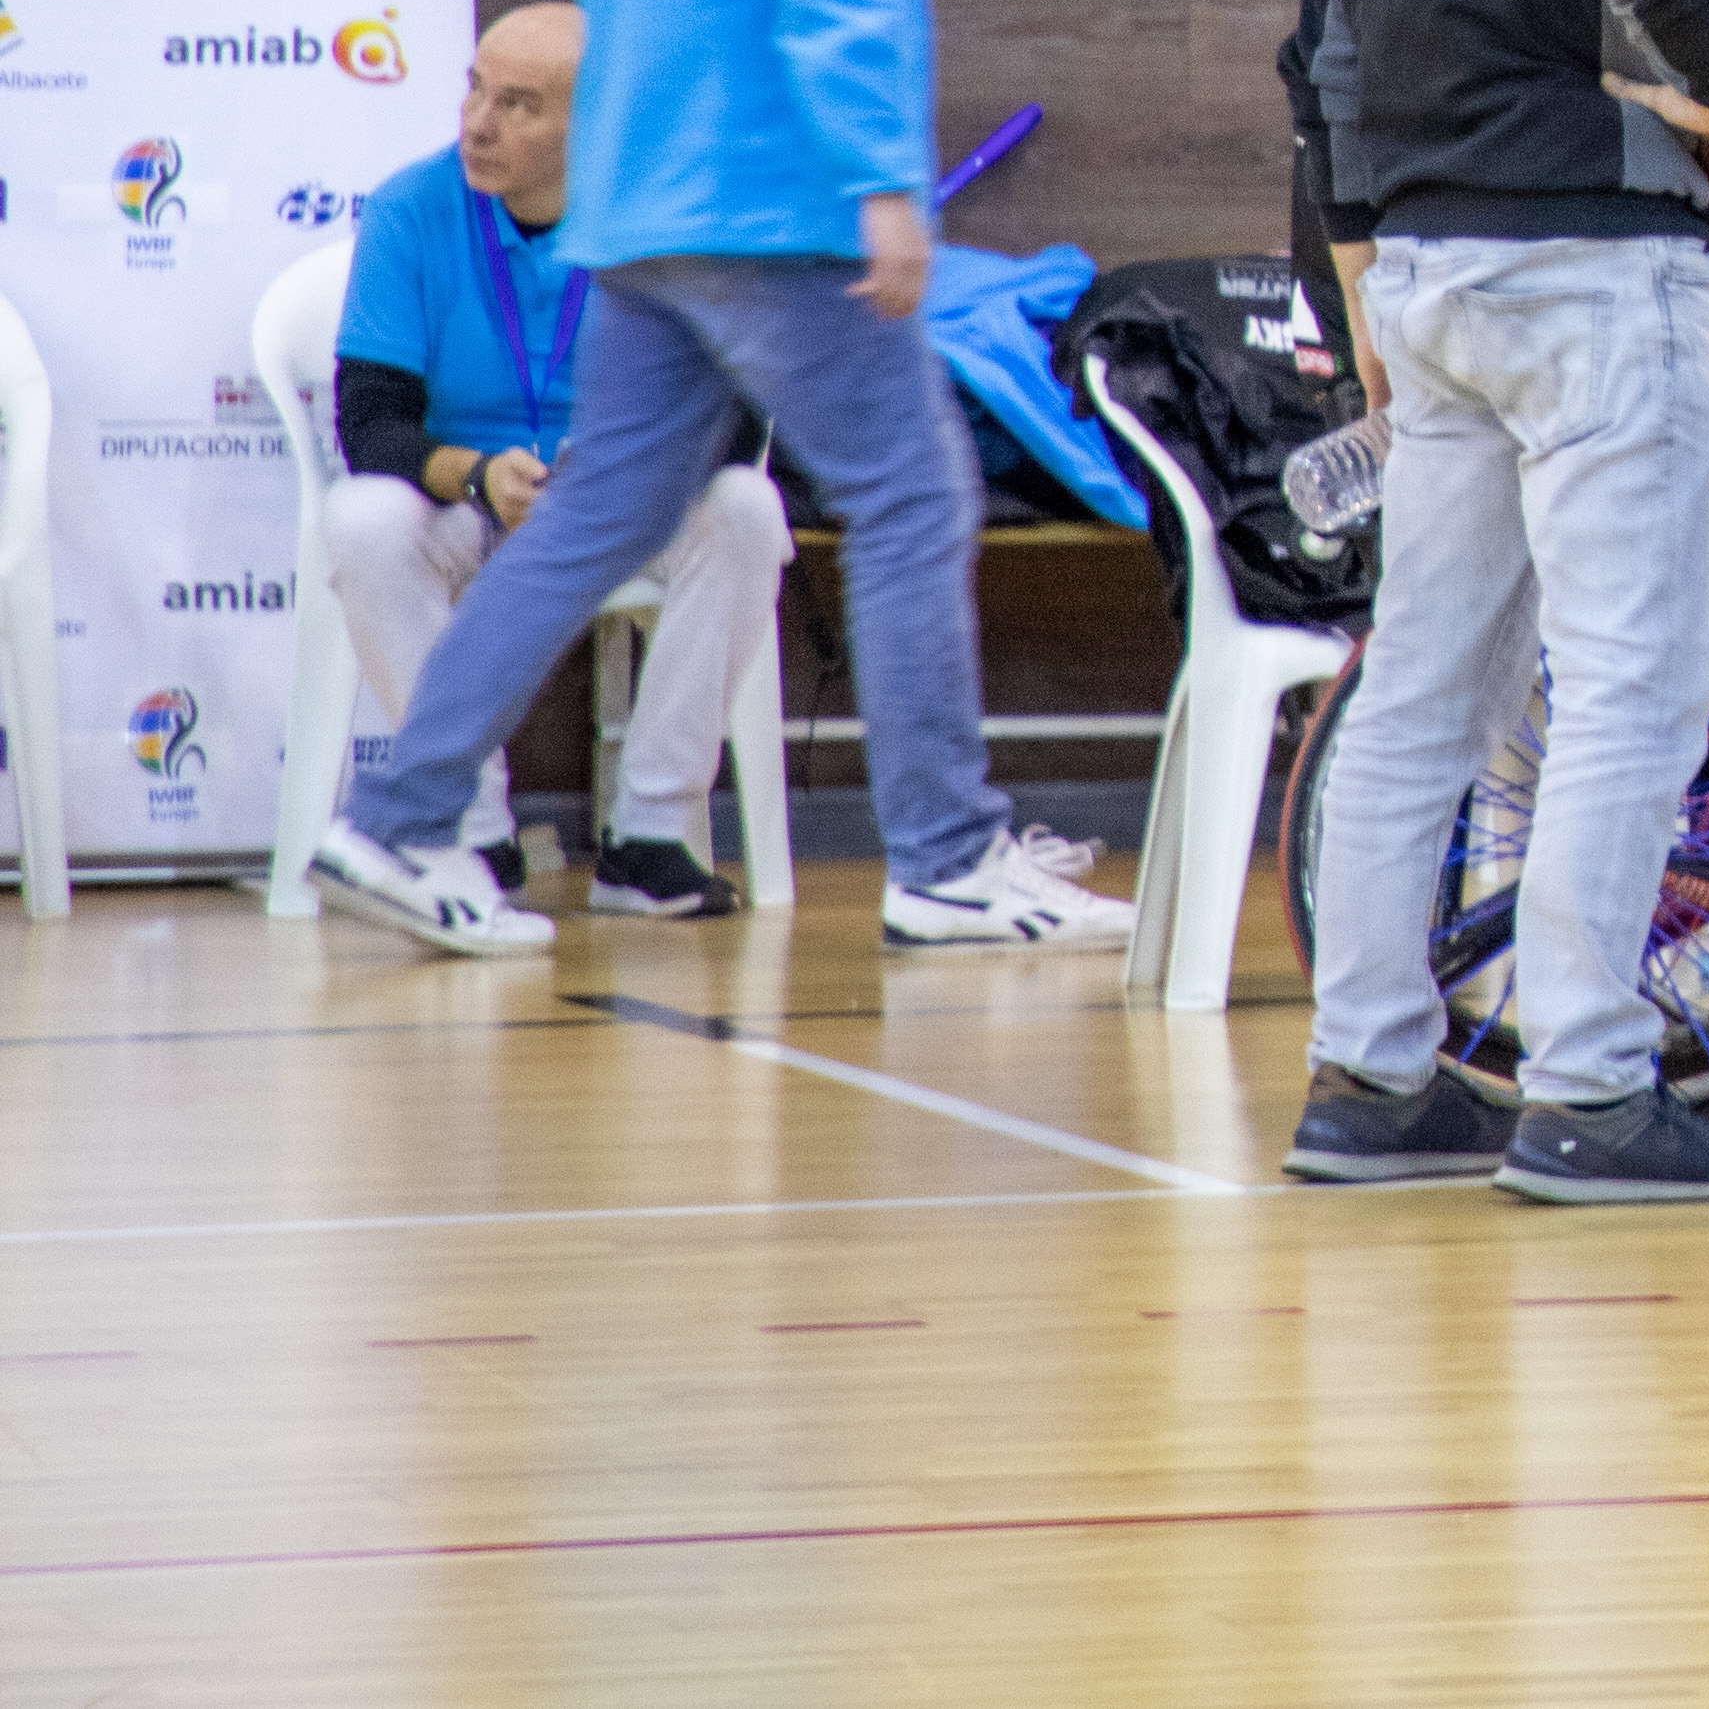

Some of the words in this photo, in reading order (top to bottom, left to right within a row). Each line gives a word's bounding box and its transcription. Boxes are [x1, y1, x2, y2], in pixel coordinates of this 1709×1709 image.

[165, 26, 322, 65] amiab
[101, 432, 250, 458] DIPUTACIÓN
[163, 571, 296, 611] amia
